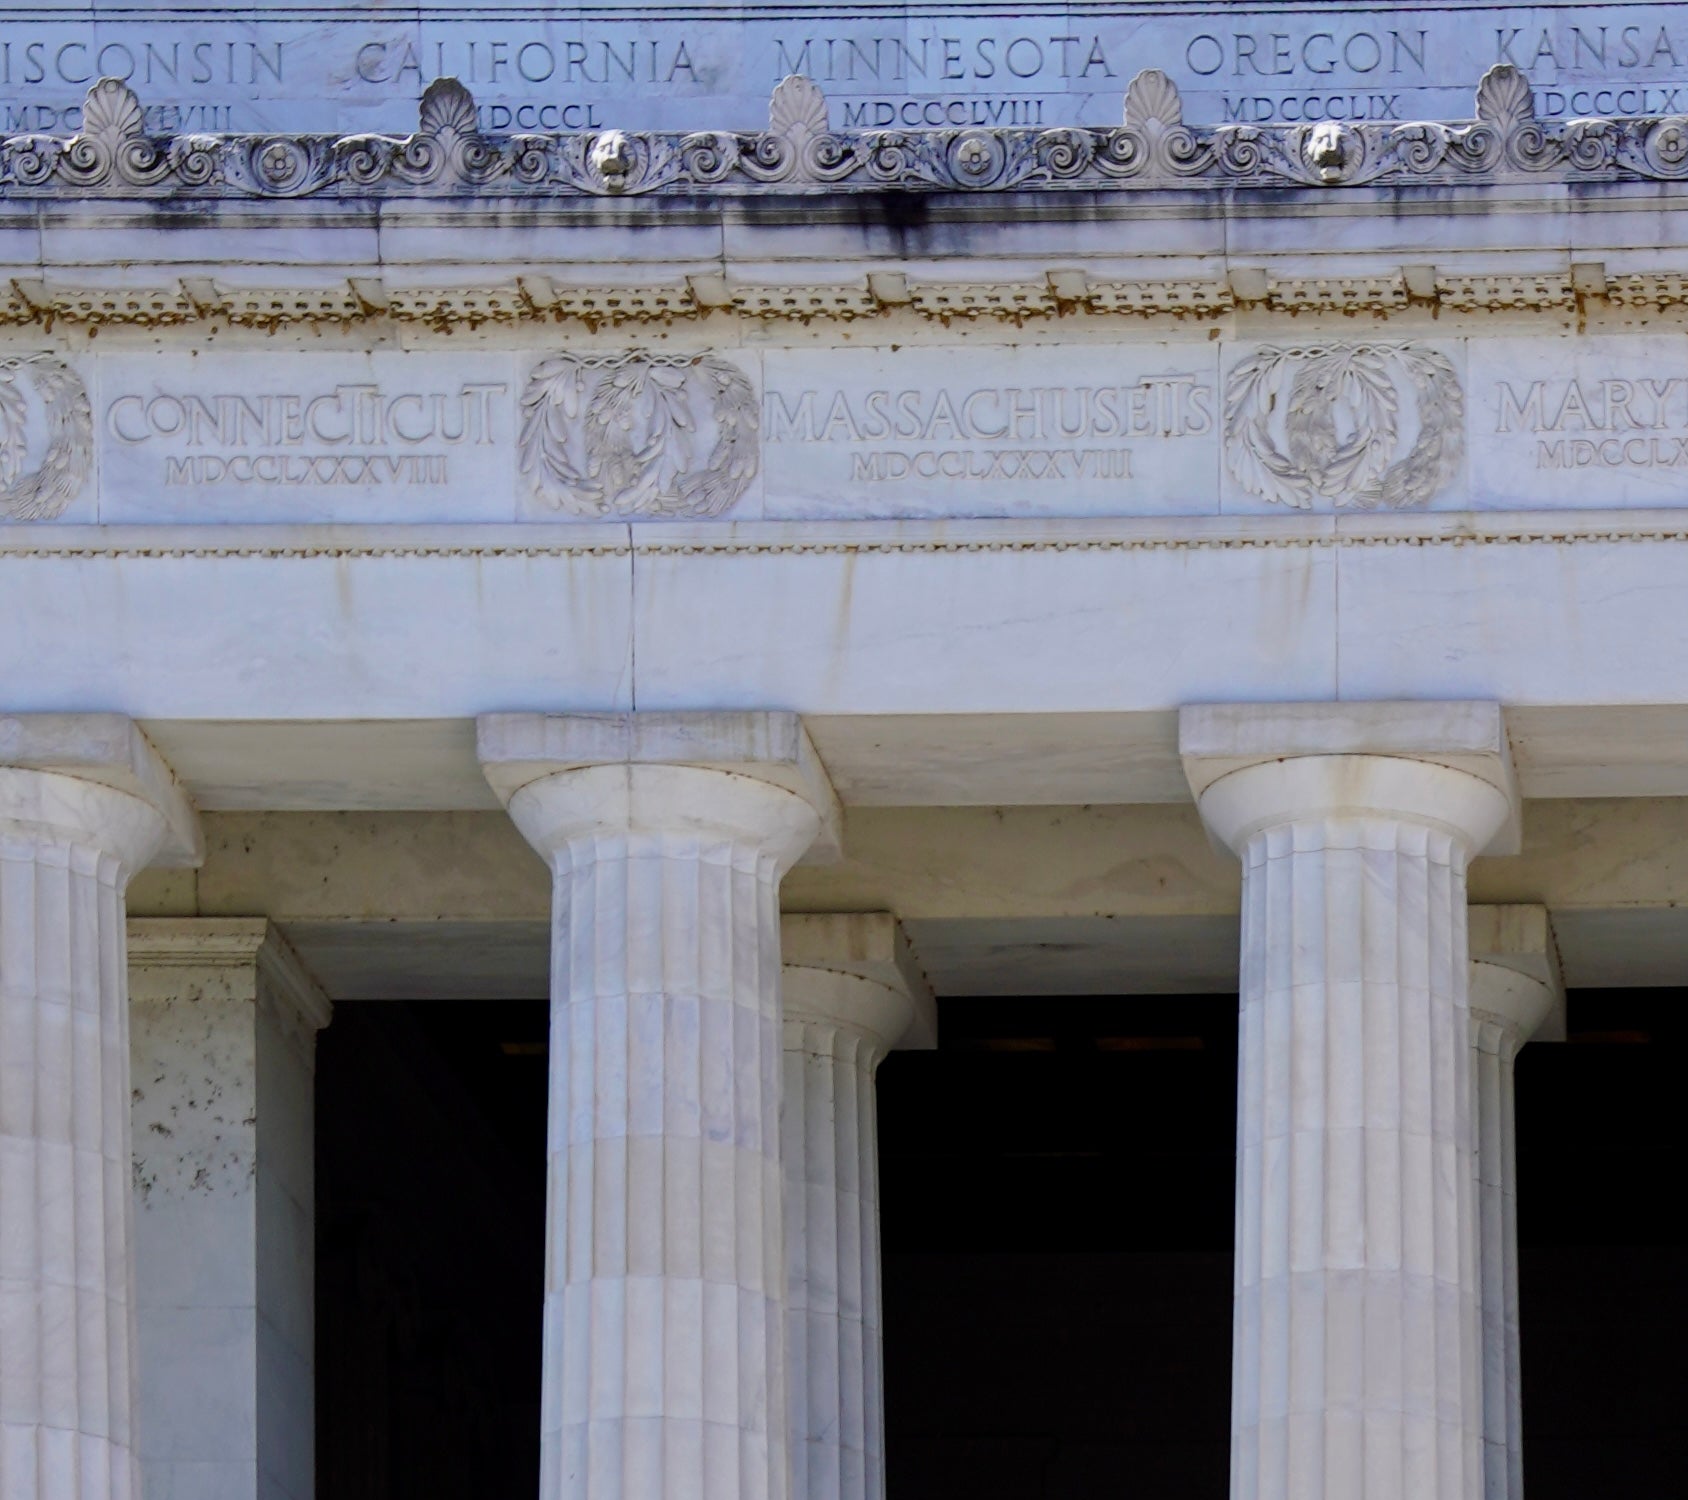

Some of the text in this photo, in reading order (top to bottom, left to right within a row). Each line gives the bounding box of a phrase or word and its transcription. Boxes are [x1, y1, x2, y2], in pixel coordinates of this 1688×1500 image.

[2, 42, 284, 84] ISCONSIN
[356, 39, 703, 84] CALIFORNIA
[773, 36, 1117, 81] MINNESOTA
[1186, 30, 1429, 76] OREGON
[842, 100, 1044, 127] MDCCCLVIII
[1221, 94, 1401, 123] MDCCCLIX
[106, 383, 507, 446] CONNECTICUT
[765, 374, 1212, 442] MASSACHUSETTS
[165, 455, 448, 486] MDCCLXXXVIII
[850, 448, 1134, 482] MDCCLXXXVIII
